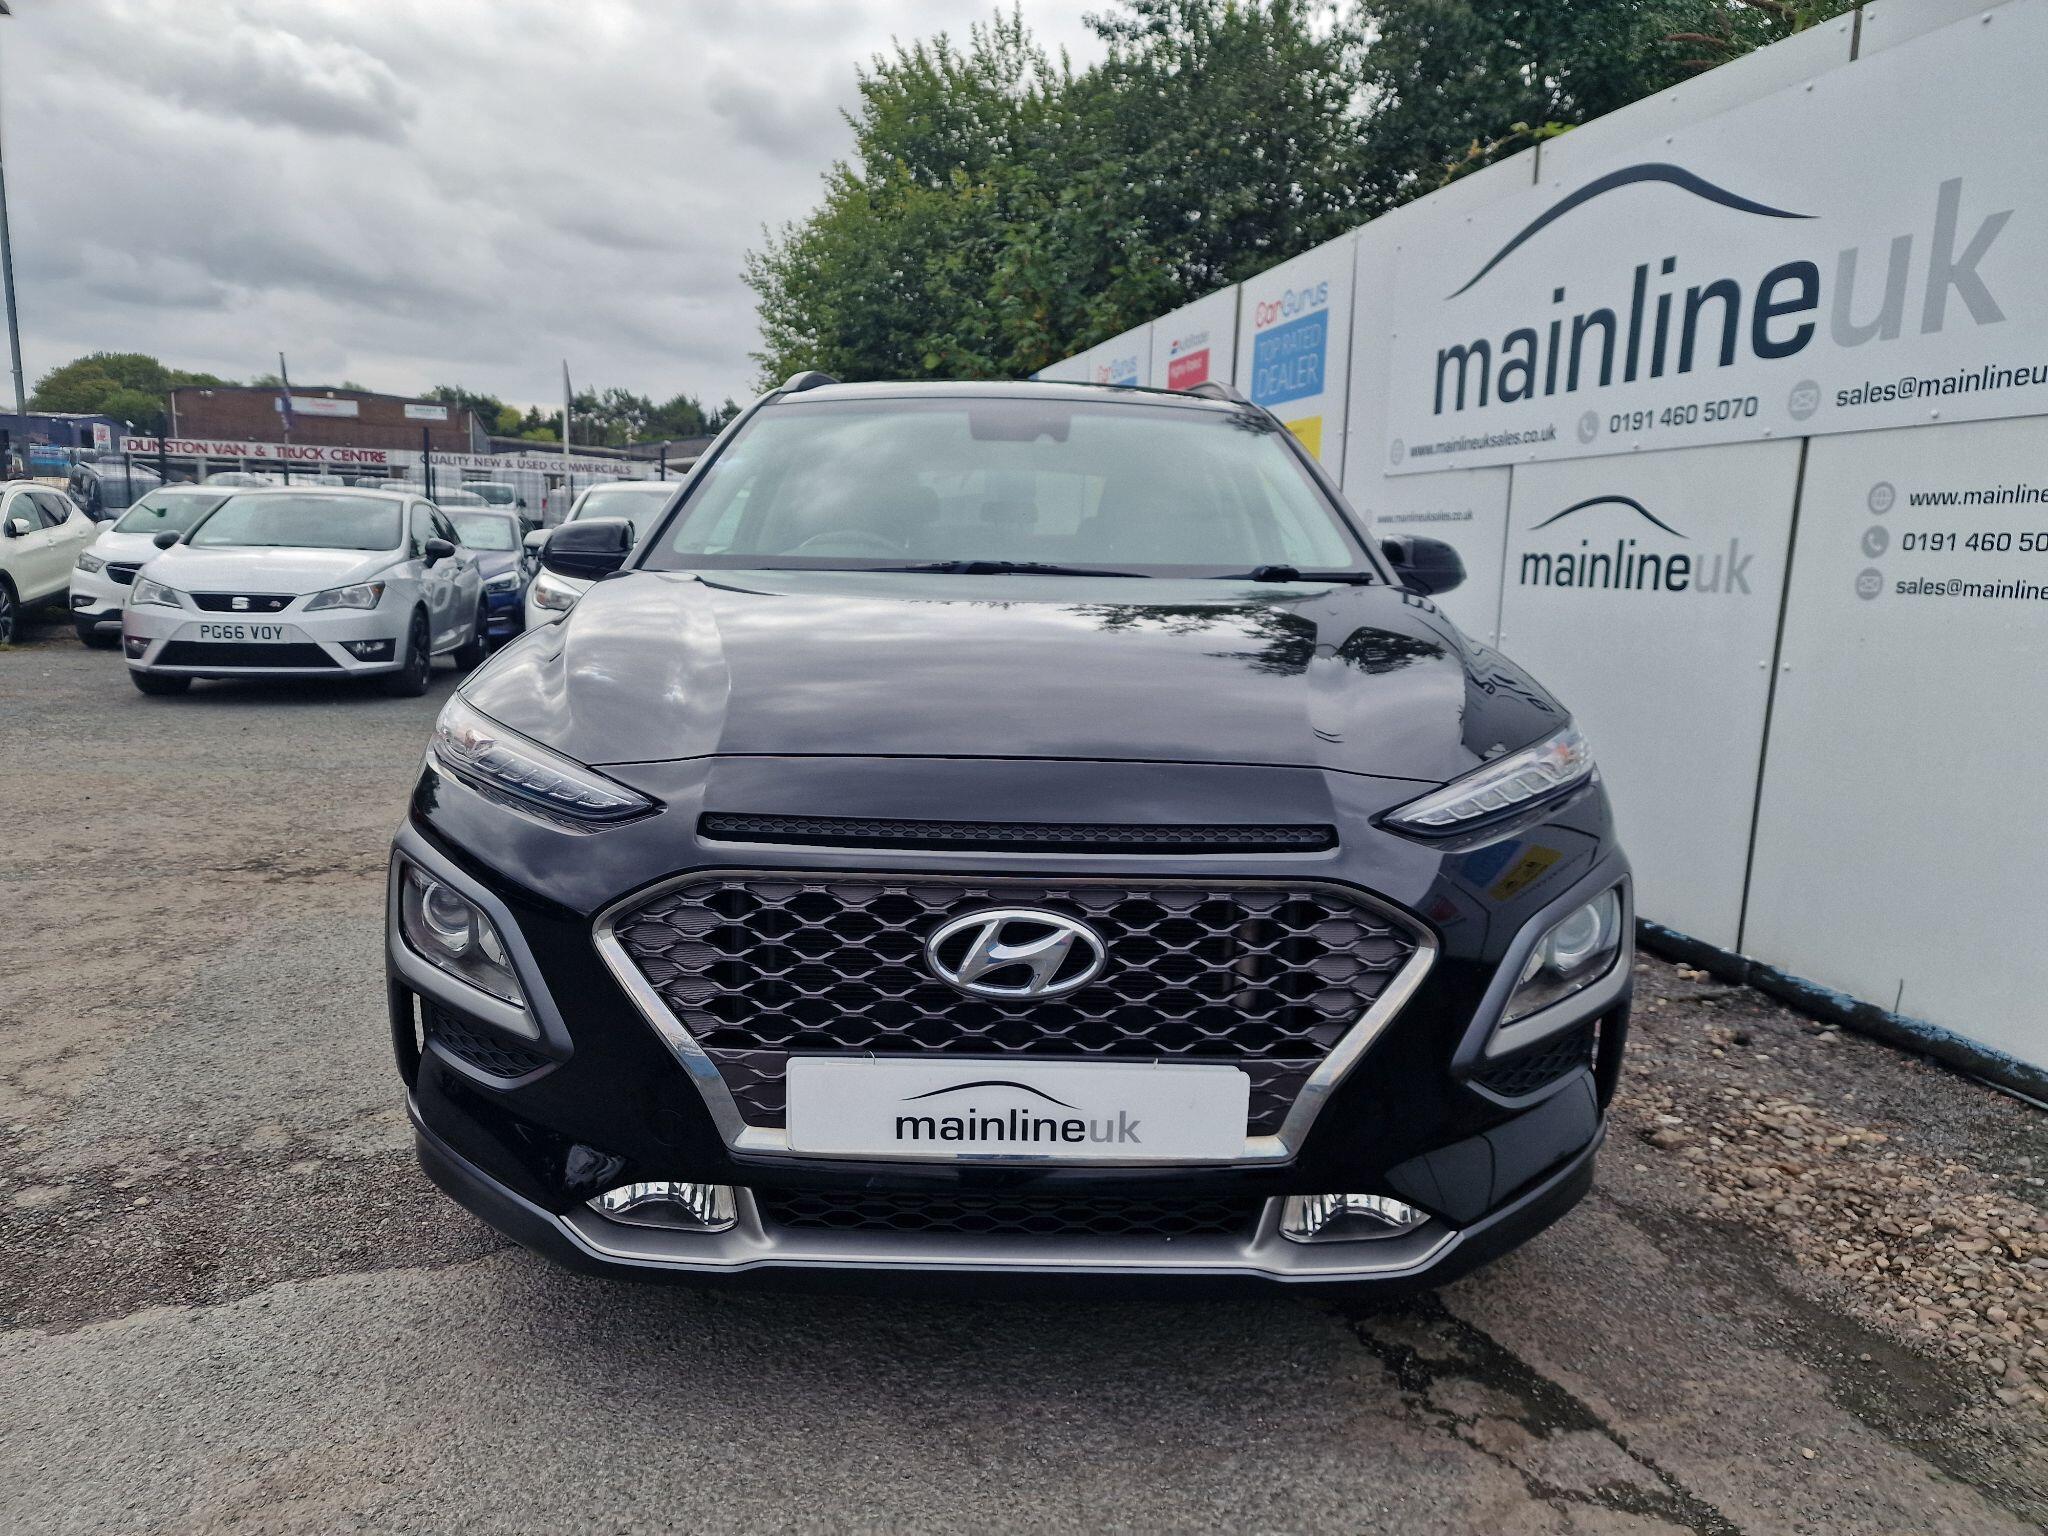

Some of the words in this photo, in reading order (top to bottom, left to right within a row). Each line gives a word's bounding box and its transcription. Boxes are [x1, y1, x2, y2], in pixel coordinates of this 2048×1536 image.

[1255, 281, 1328, 328] CarGurus
[1433, 176, 2015, 415] mainlineuk
[1259, 336, 1281, 361] TOP
[1281, 323, 1322, 355] RATED
[1257, 353, 1319, 398] DEALER
[1609, 410, 1653, 433] 0191
[1659, 404, 1698, 426] 460
[1703, 396, 1759, 422] 5070
[212, 443, 248, 456] VAN
[255, 446, 267, 457] &
[274, 446, 326, 460] TRUCK
[331, 449, 387, 463] CENTRE
[474, 457, 501, 468] NEW
[504, 459, 512, 469] &
[517, 459, 547, 470] USED
[1902, 532, 1957, 552] 0191
[1964, 532, 2013, 552] 460
[2018, 532, 2048, 552] 50
[1520, 538, 1755, 595] mainlineuk
[200, 625, 245, 639] PG66
[250, 626, 283, 640] VOY
[895, 1108, 1143, 1144] mainlineuk
